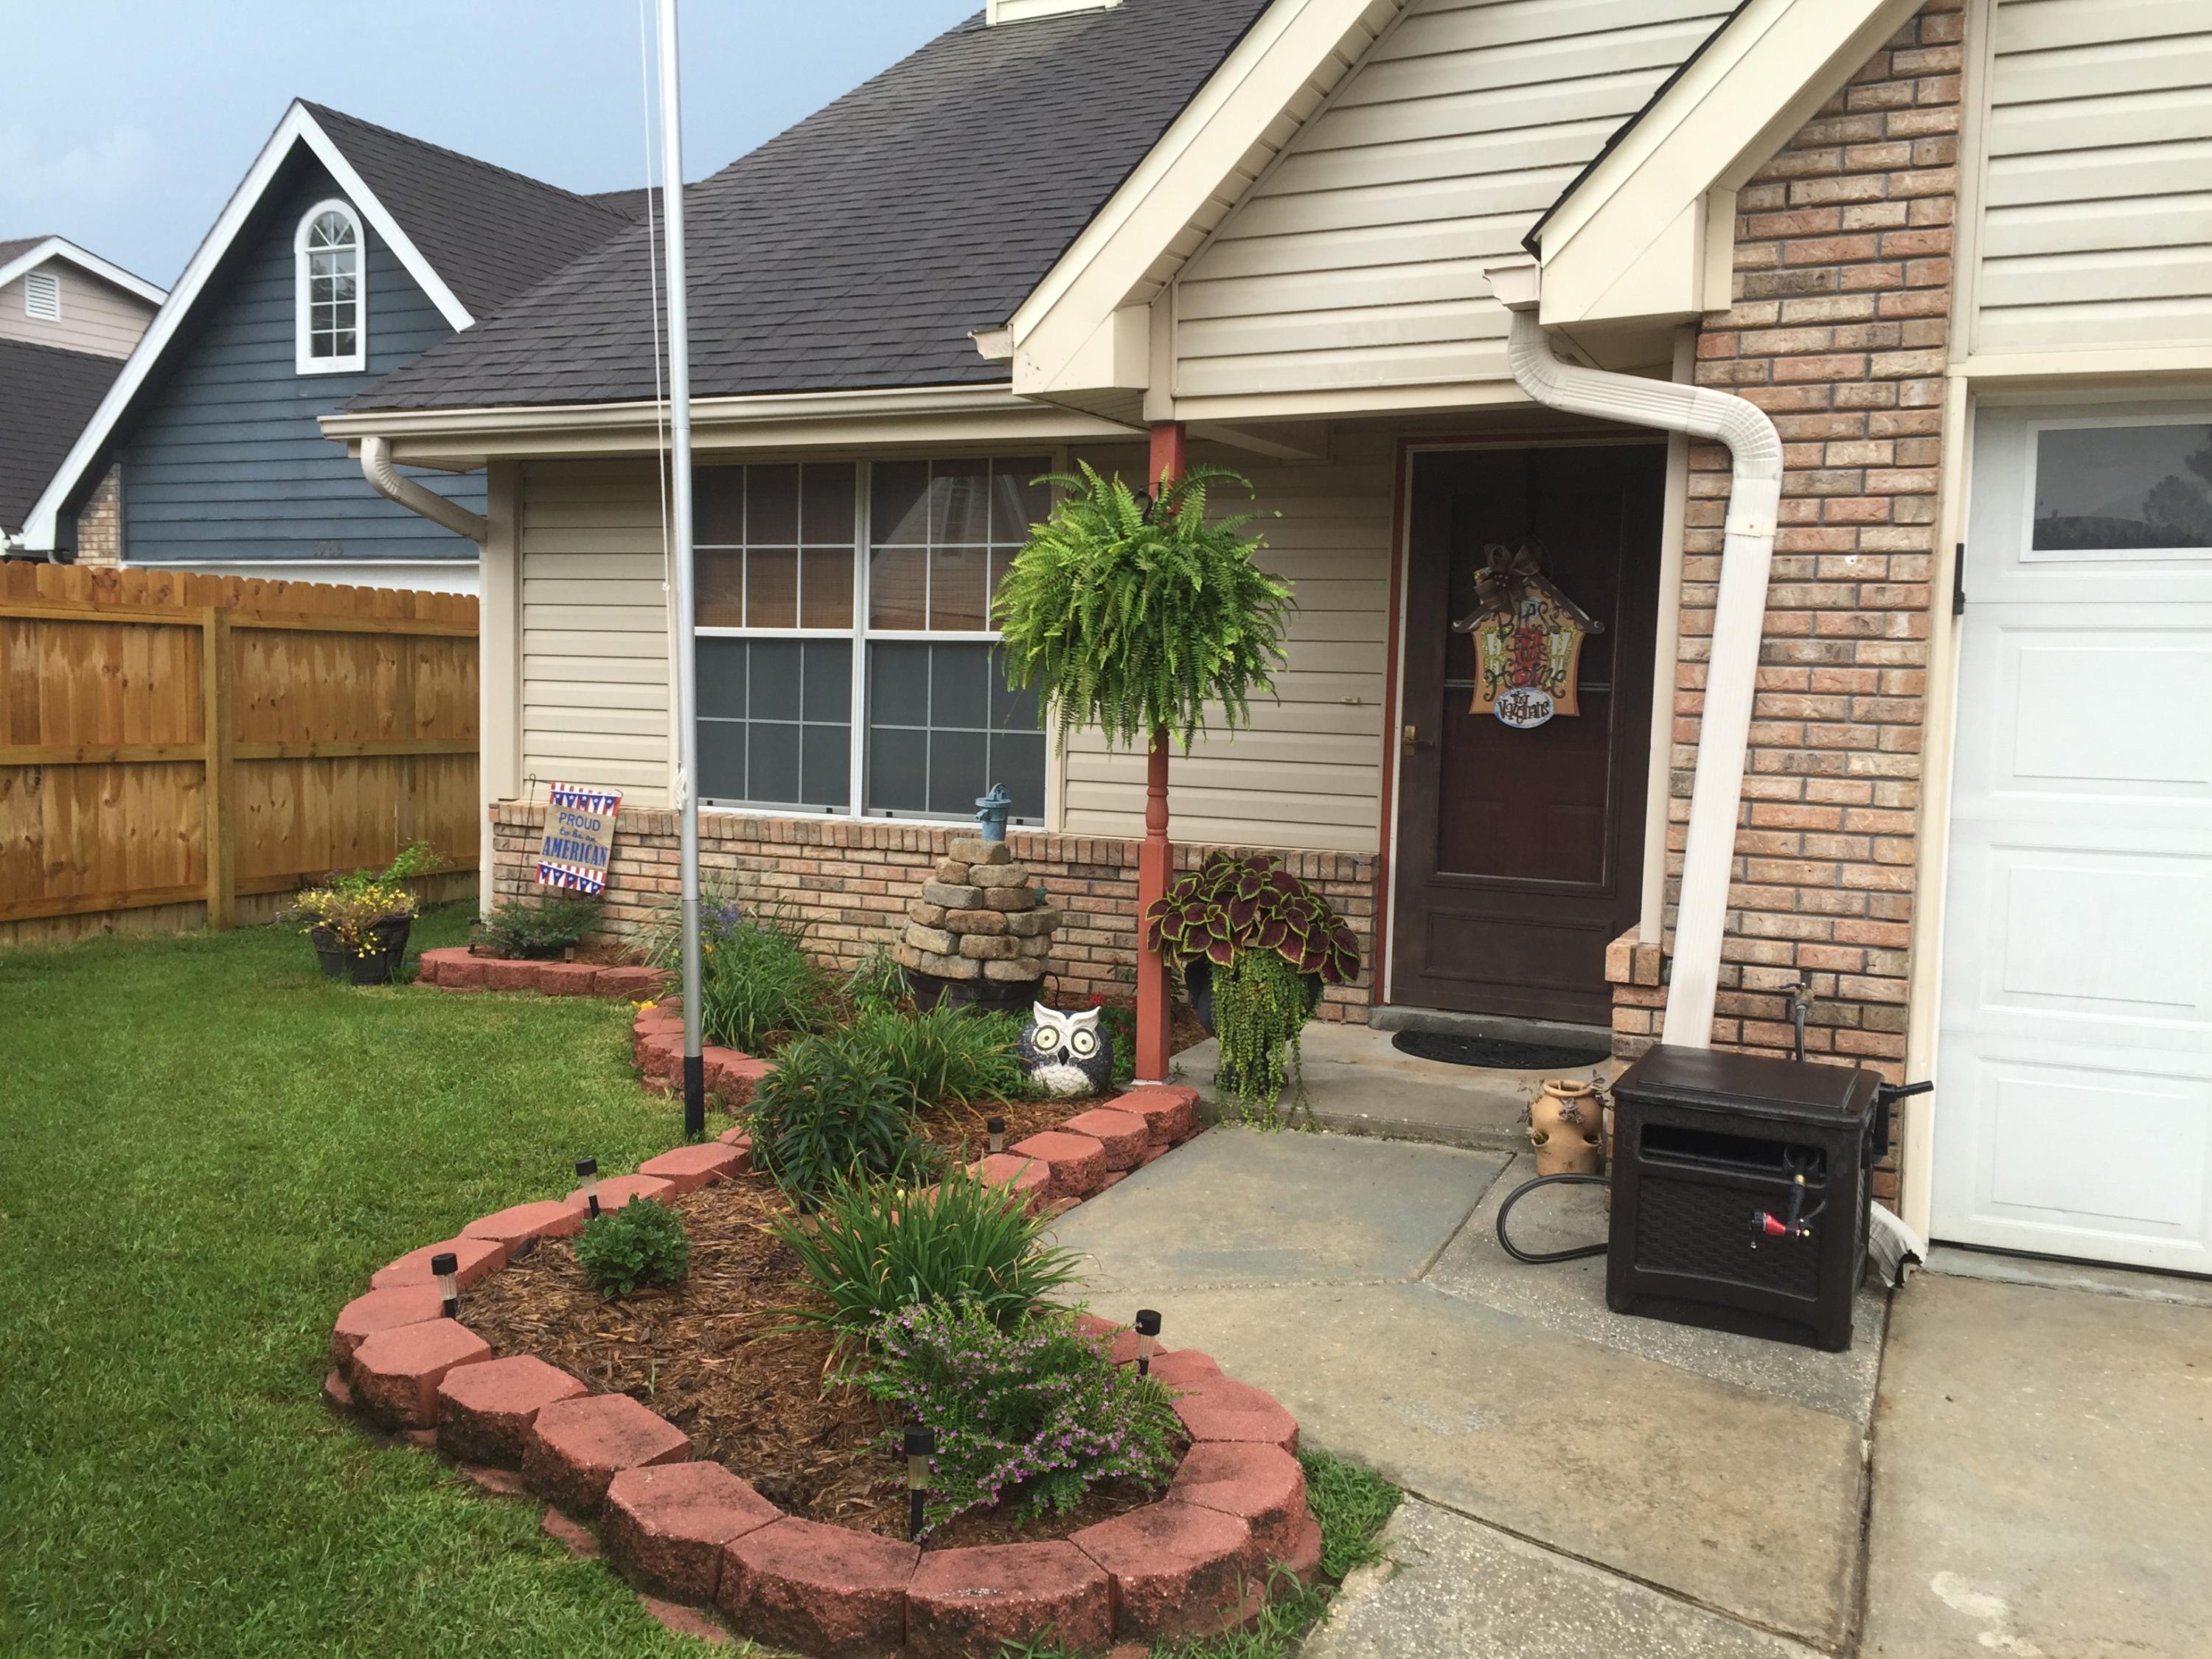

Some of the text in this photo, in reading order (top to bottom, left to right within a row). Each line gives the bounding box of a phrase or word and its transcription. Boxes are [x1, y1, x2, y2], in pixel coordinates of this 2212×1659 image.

[1498, 695, 1549, 724] Vaughans
[559, 812, 601, 832] PROUD
[559, 827, 597, 843] to be an
[542, 836, 608, 866] AMERICAN
